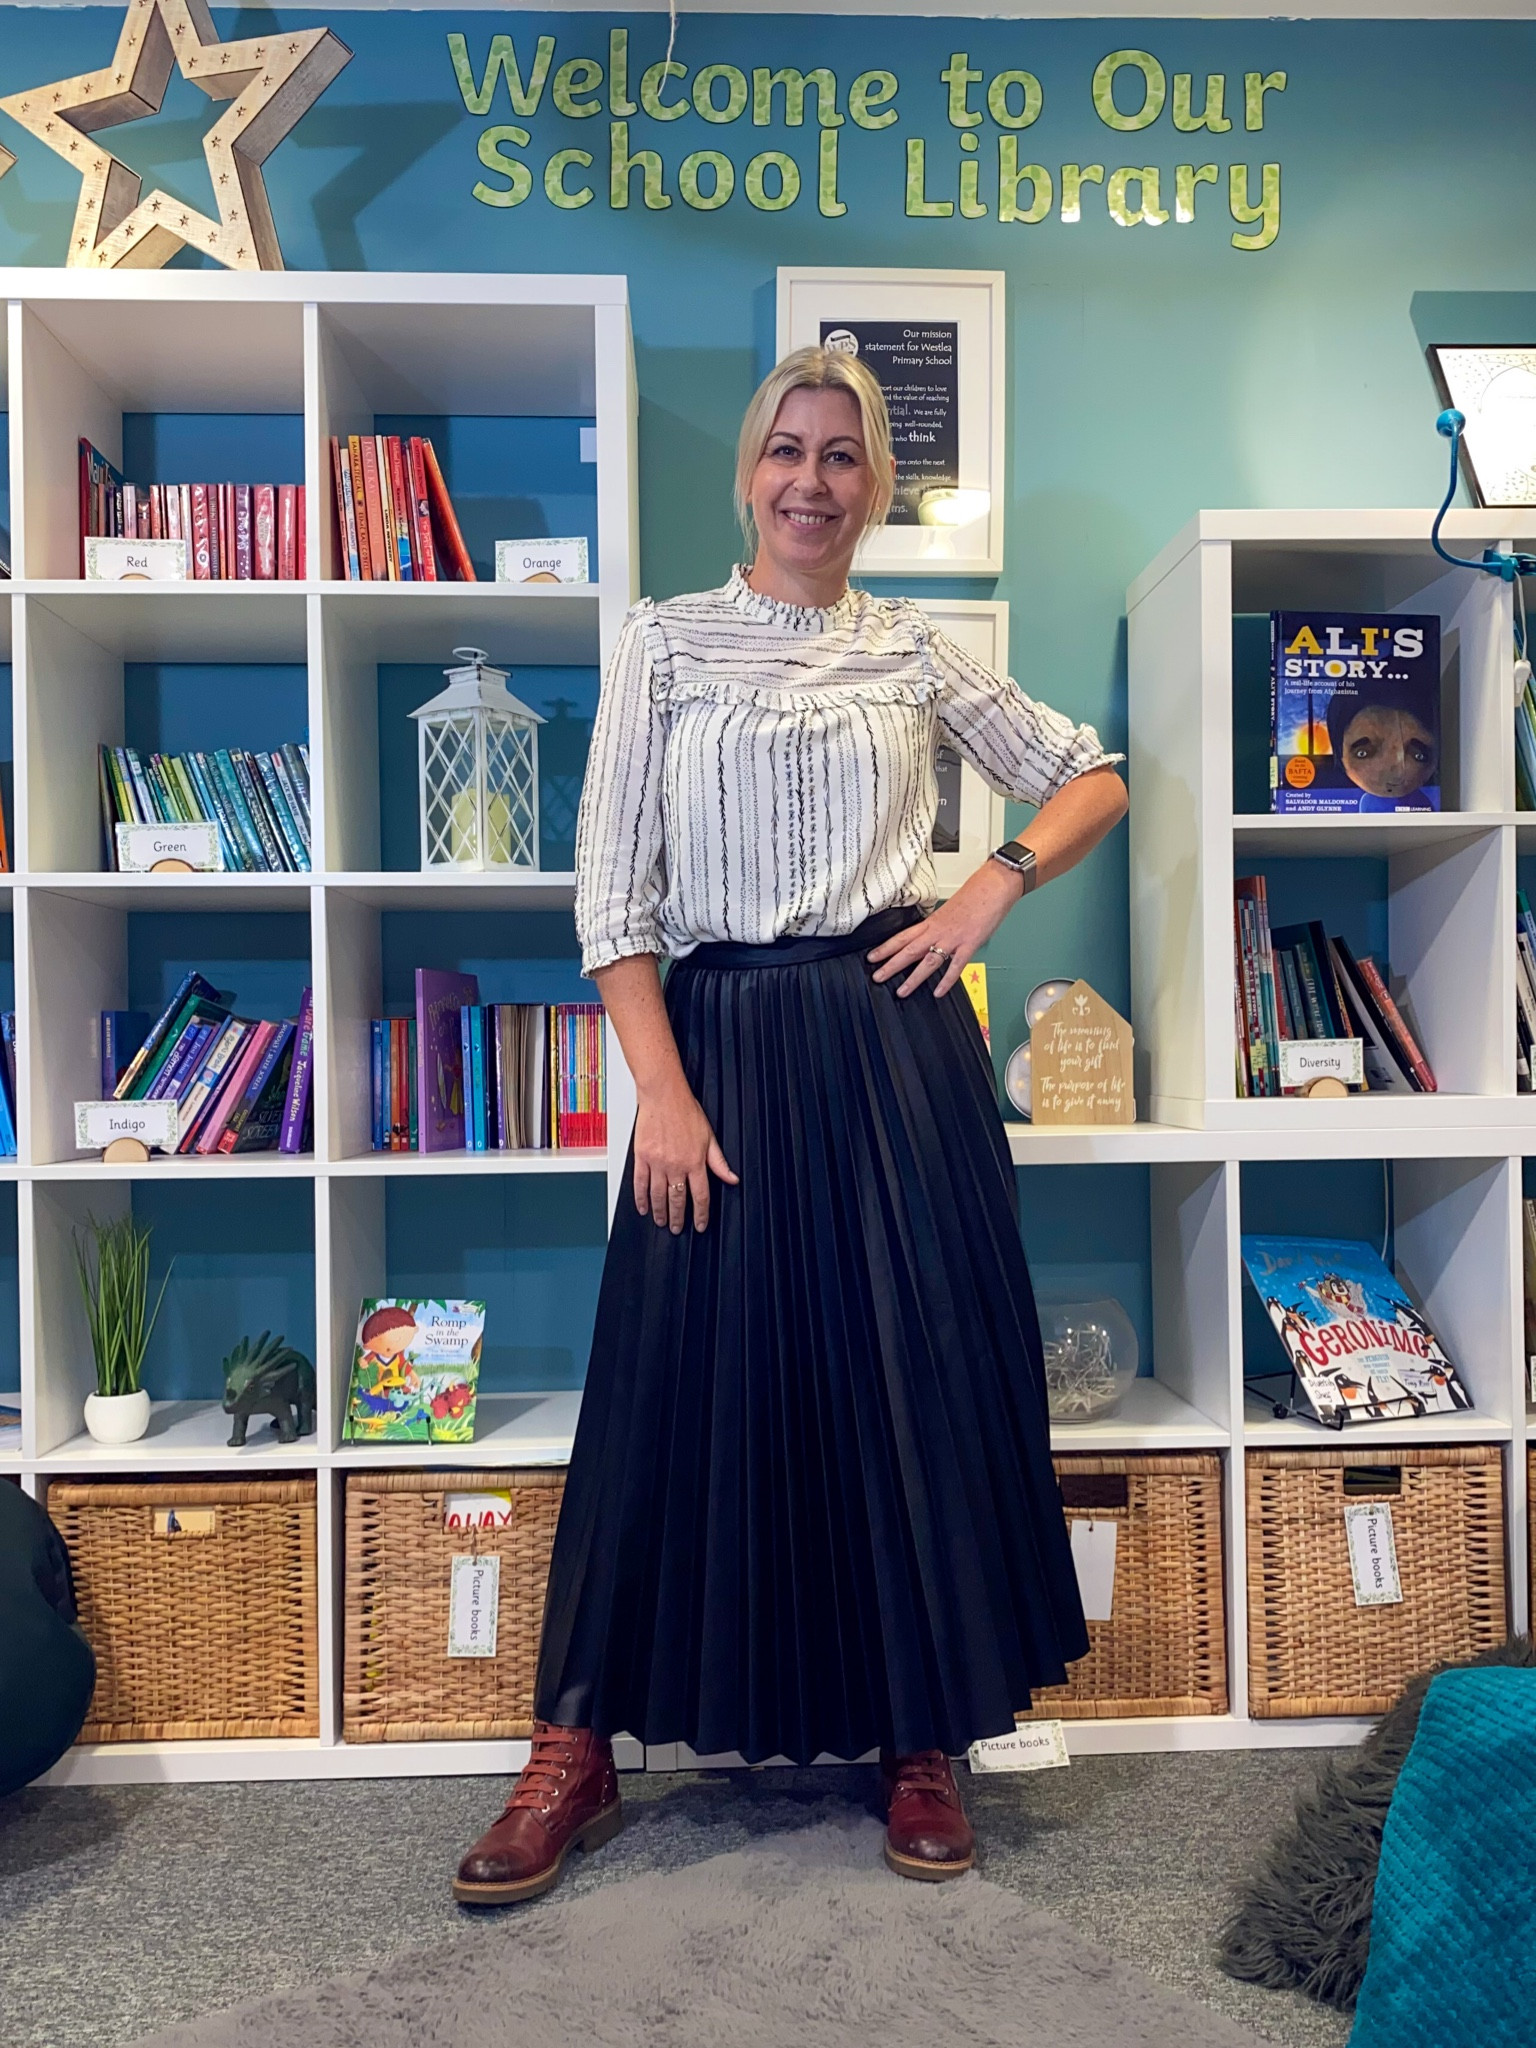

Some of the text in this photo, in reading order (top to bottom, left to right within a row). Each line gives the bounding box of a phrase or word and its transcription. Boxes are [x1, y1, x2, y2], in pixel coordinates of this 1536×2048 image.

[446, 28, 1288, 134] Welcome to Our
[470, 121, 1281, 250] School Library
[903, 329, 952, 339] Our mission
[865, 341, 952, 352] statement for Westlea
[893, 355, 952, 367] Primary School
[904, 384, 926, 392] children
[926, 394, 950, 403] reaching
[913, 408, 923, 416] We
[934, 408, 947, 417] fully
[909, 430, 936, 443] think
[351, 441, 360, 467] SAHARA
[363, 441, 373, 473] JACKIE
[367, 476, 376, 494] KAY
[126, 555, 148, 568] Red
[523, 557, 562, 571] Orange
[1284, 625, 1424, 658] ALI'S
[1284, 658, 1409, 680] STORY...
[1323, 688, 1358, 696] Afghanistan
[153, 841, 187, 852] Green
[1051, 1021, 1112, 1039] The meaning
[1043, 1037, 1120, 1055] of life is to find
[1060, 1053, 1104, 1072] your gift
[1299, 1057, 1341, 1070] Diversity
[293, 1060, 308, 1099] Jacqueline
[1040, 1075, 1126, 1094] The purpose of life
[289, 1097, 301, 1122] Wilson
[1041, 1093, 1122, 1112] is to give it away
[109, 1119, 146, 1133] Indigo
[432, 1315, 467, 1330] Romp
[446, 1328, 459, 1337] the
[424, 1334, 469, 1348] Swamp
[1367, 1518, 1385, 1589] Picture books
[470, 1569, 484, 1641] Picture books
[980, 1736, 1050, 1751] Picture books
